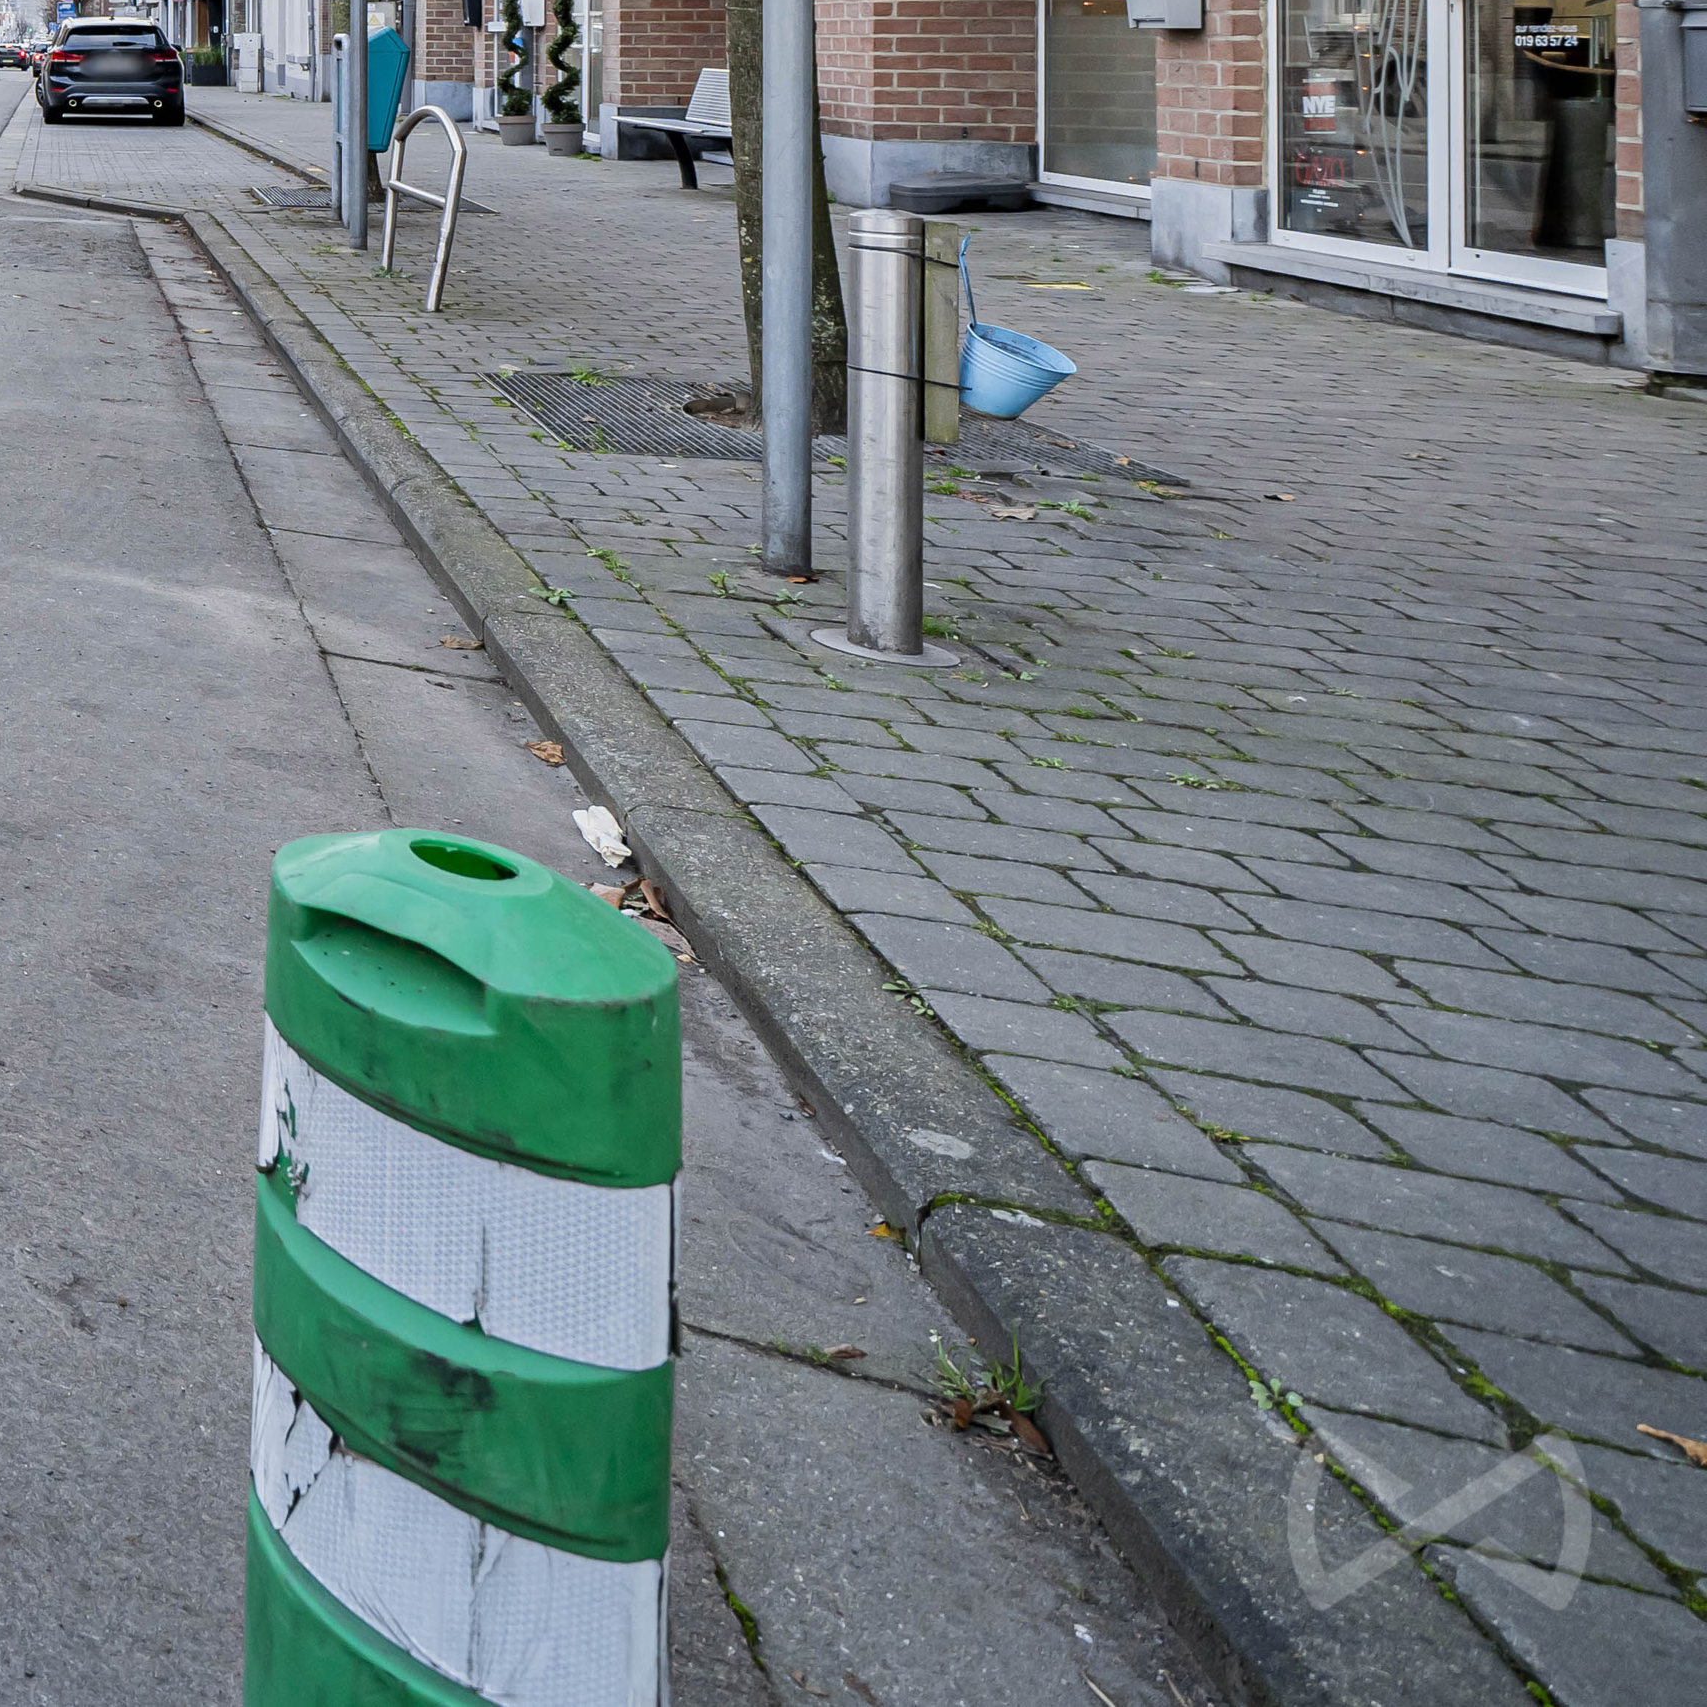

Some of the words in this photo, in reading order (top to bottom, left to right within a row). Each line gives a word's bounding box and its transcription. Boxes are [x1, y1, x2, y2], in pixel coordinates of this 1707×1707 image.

[1515, 35, 1533, 47] 019
[1535, 35, 1548, 47] 63
[1549, 35, 1562, 47] 57
[1564, 35, 1579, 47] 24
[1302, 95, 1336, 114] NYE
